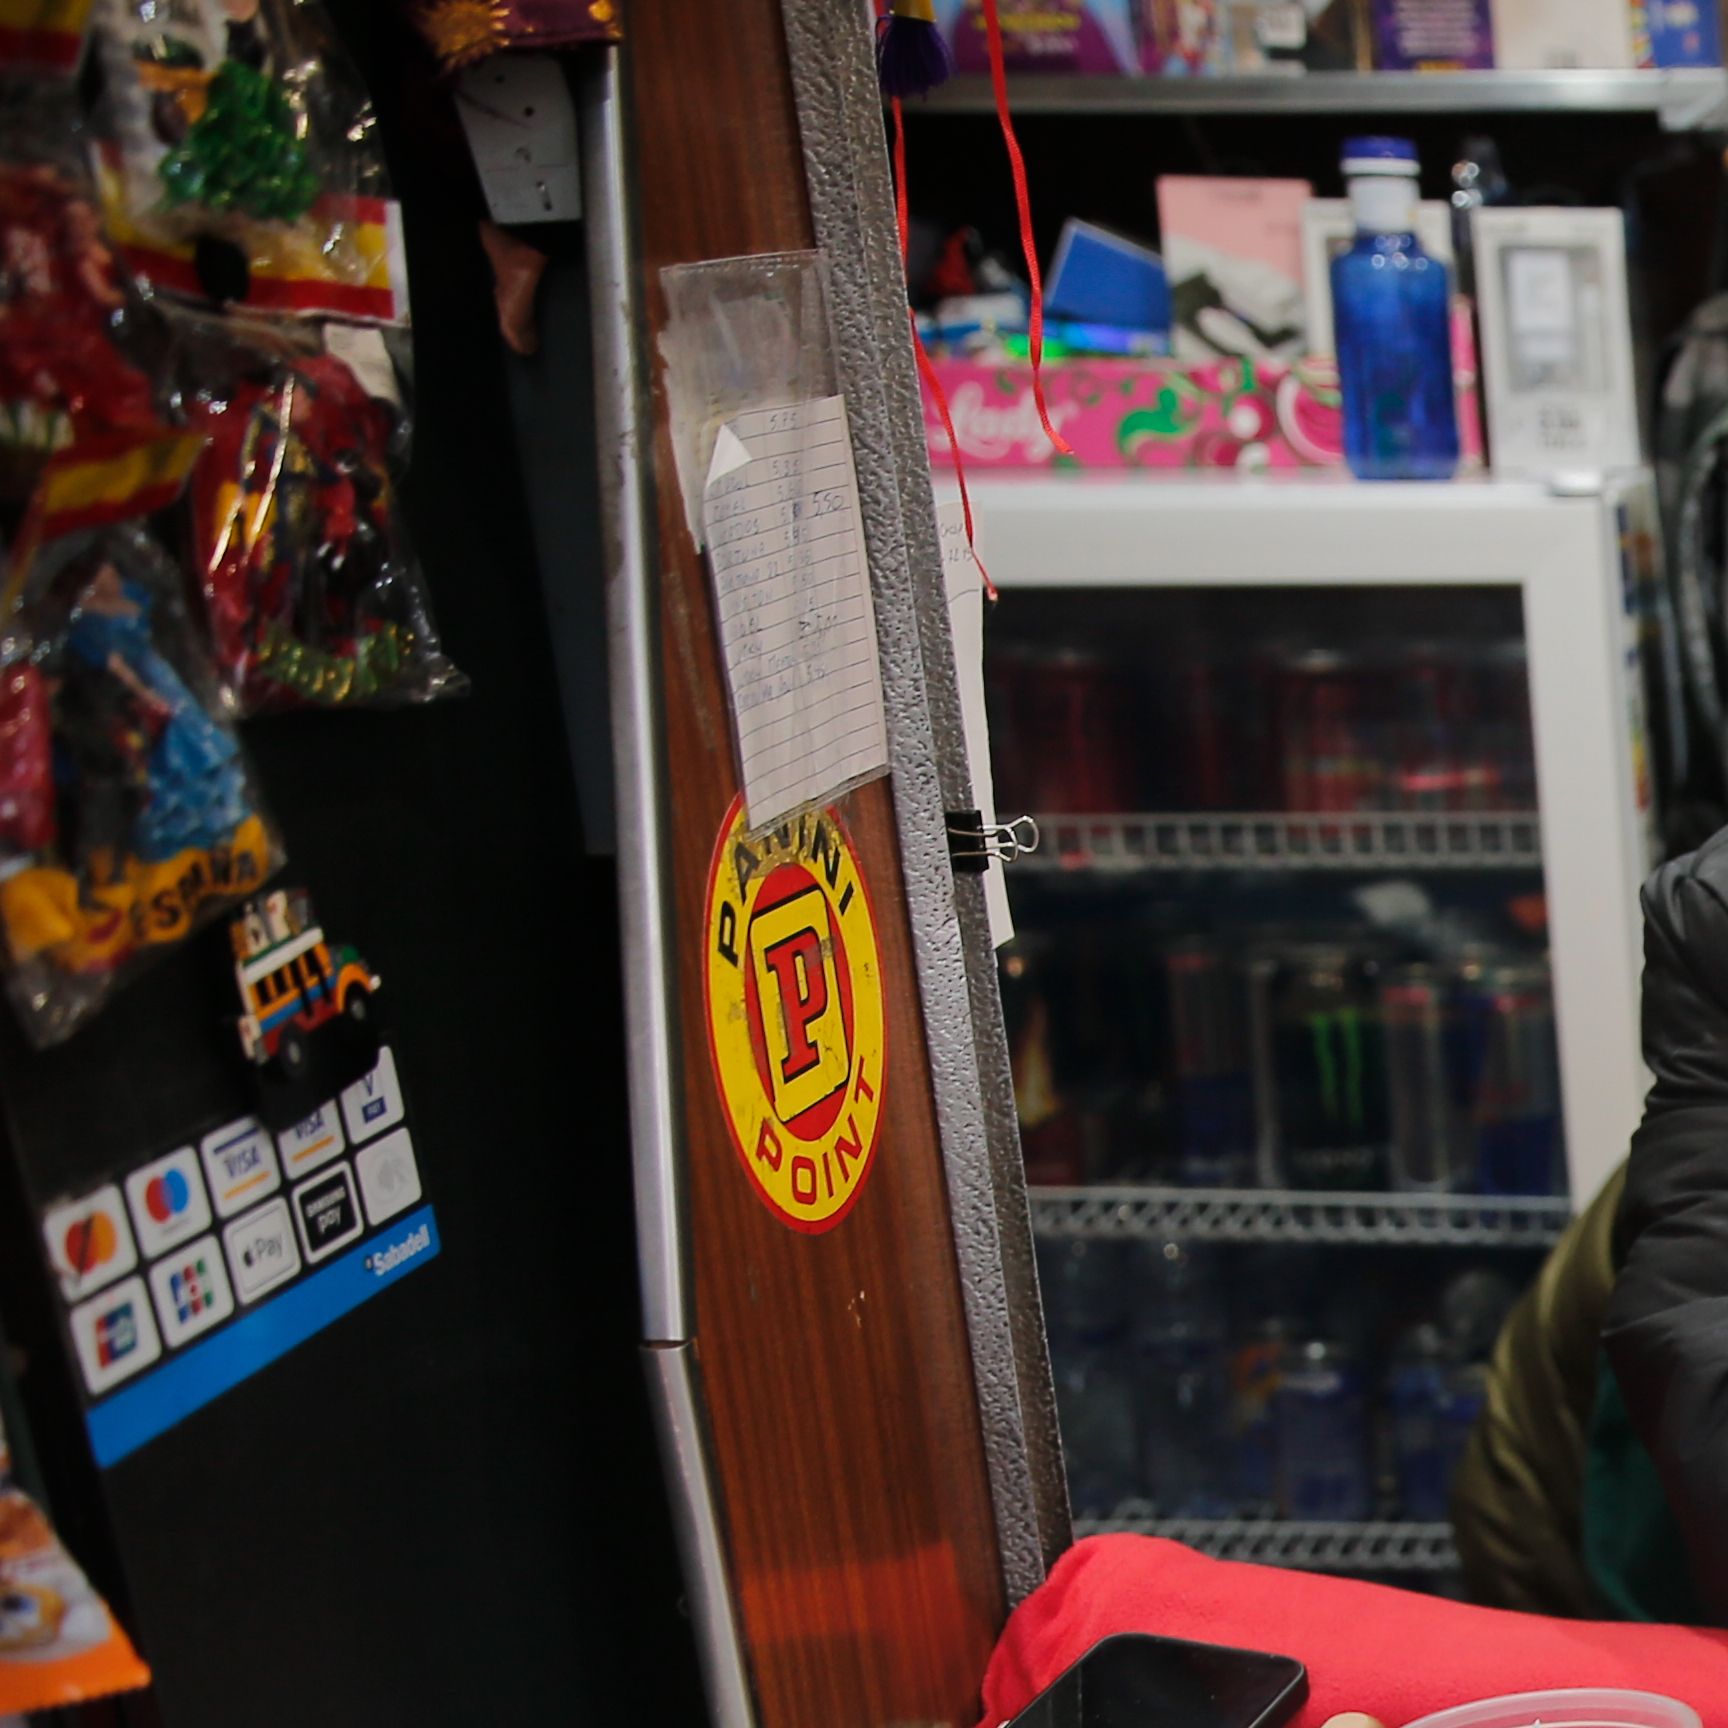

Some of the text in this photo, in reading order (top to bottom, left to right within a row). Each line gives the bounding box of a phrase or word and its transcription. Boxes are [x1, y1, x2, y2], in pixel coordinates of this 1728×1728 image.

[764, 924, 829, 1085] P
[225, 1146, 261, 1180] VISA
[754, 1055, 876, 1206] POINT
[371, 1223, 431, 1277] Sabadell
